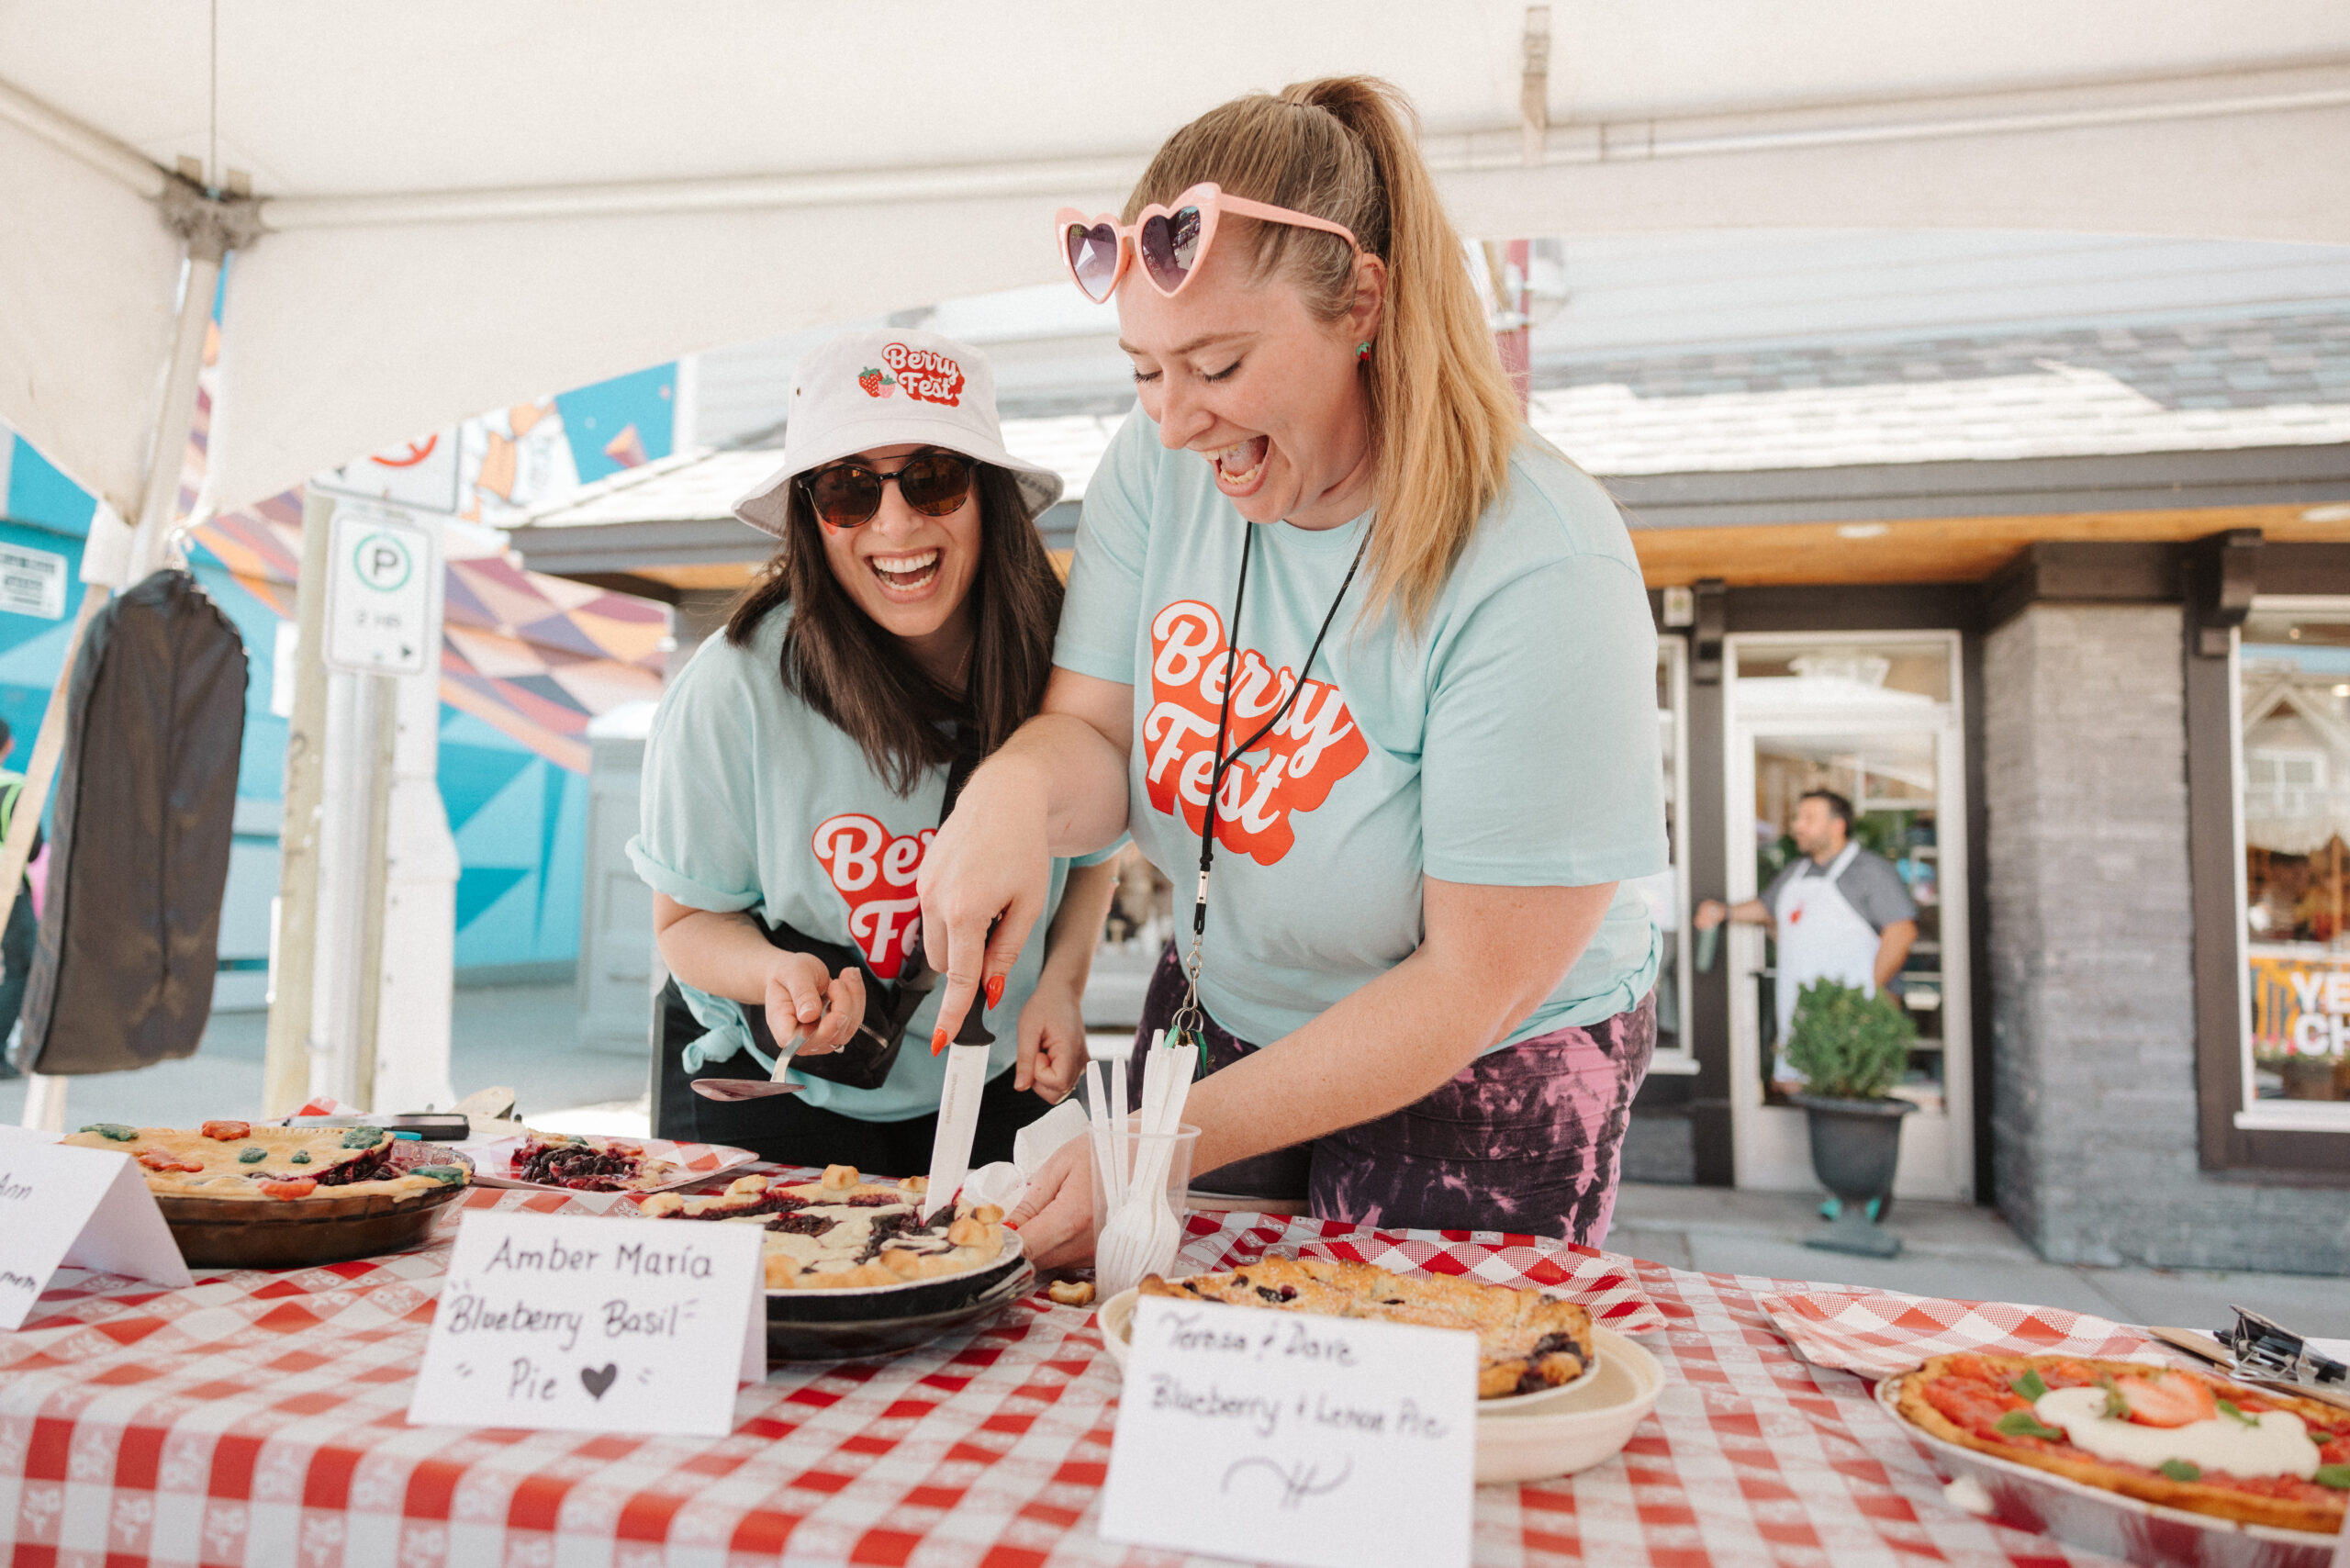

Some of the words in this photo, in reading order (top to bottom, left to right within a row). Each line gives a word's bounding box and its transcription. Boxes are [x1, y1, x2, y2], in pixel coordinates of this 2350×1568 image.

[881, 342, 959, 386] Berry
[899, 372, 954, 400] Fest
[374, 549, 397, 576] P
[1152, 601, 1355, 779] Berry
[1144, 701, 1289, 835] Fest
[485, 1236, 599, 1273] Amber
[614, 1242, 713, 1279] María
[447, 1294, 584, 1352] Blueberry
[602, 1298, 679, 1338] Basil
[509, 1357, 557, 1401] Pie
[1149, 1373, 1281, 1439] Blueberry
